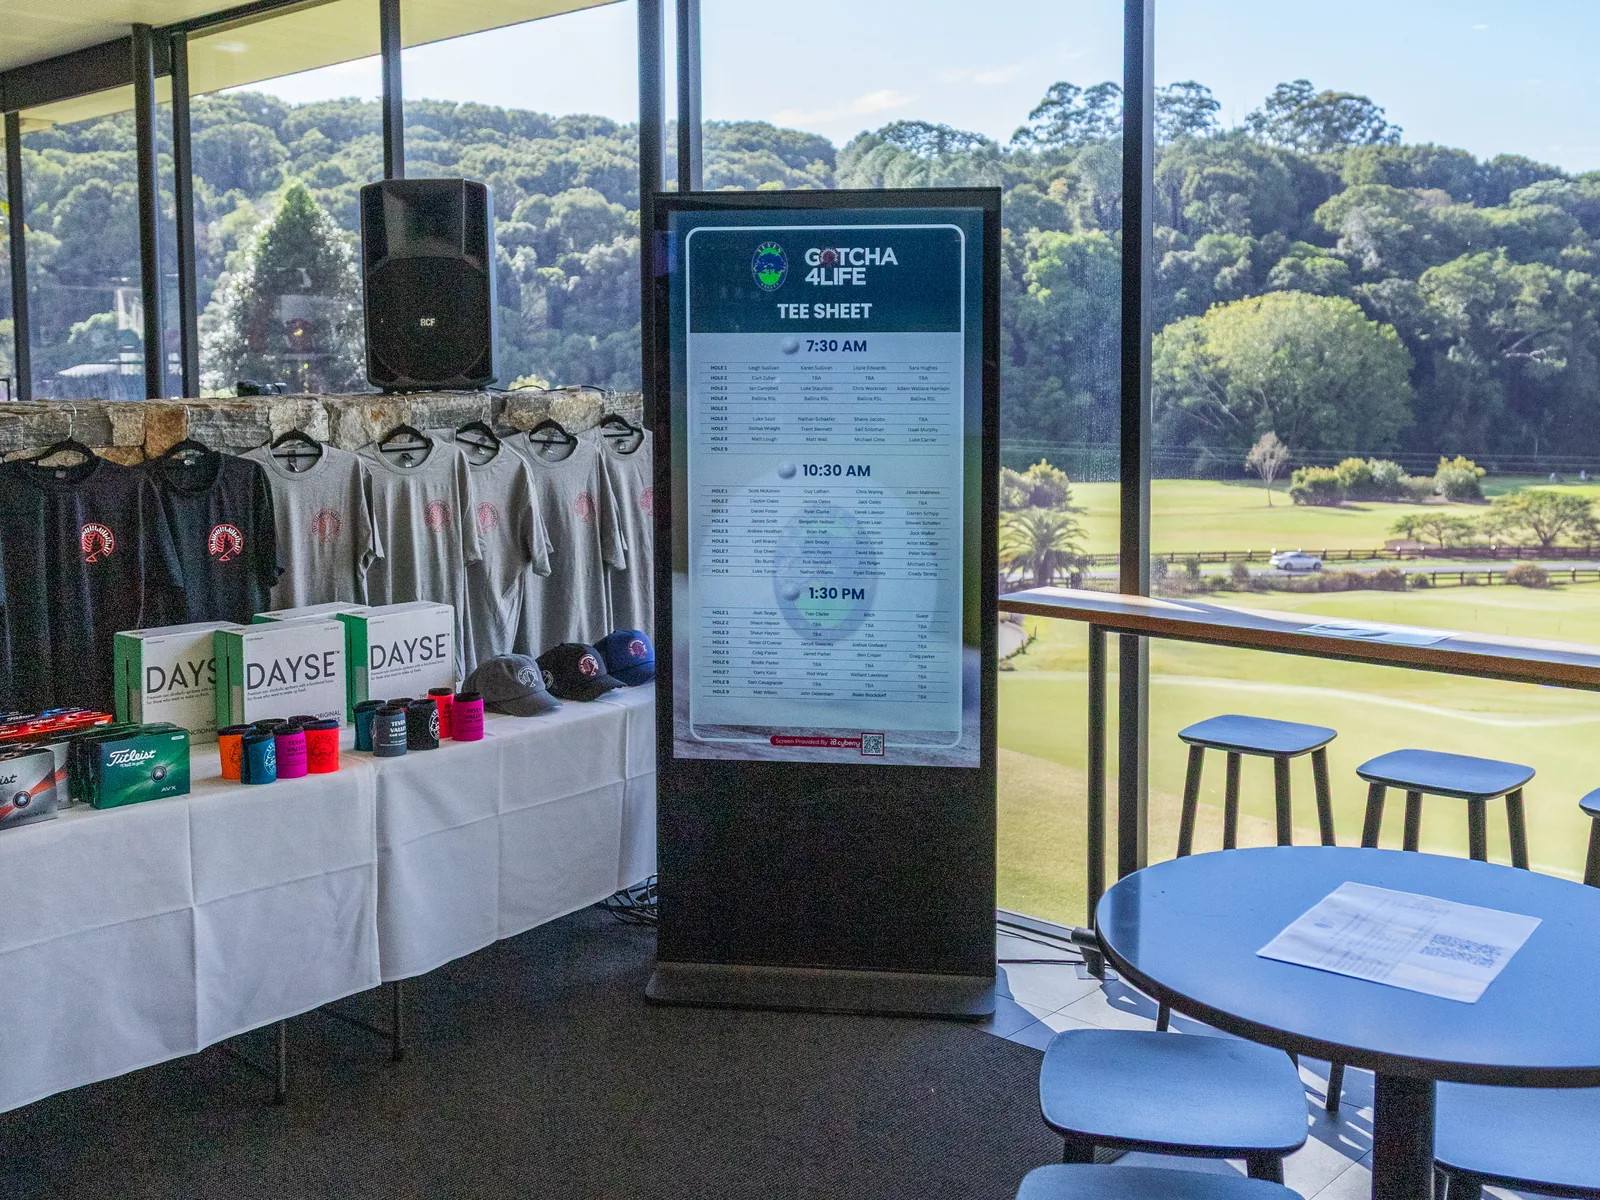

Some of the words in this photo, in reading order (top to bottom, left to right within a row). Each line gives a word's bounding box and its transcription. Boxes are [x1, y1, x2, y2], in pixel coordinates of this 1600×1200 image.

[805, 247, 898, 266] GOTCHA
[805, 268, 866, 285] 4LIFE
[777, 303, 810, 319] TEE
[814, 303, 872, 319] SHEET
[420, 318, 435, 326] RCF
[807, 340, 838, 352] 7:30
[842, 340, 867, 352] AM
[803, 464, 842, 476] 10:30
[846, 465, 870, 476] AM
[809, 587, 837, 599] 1:30
[842, 588, 864, 599] PM
[147, 658, 216, 693] DAYS
[106, 749, 156, 766] Titleist
